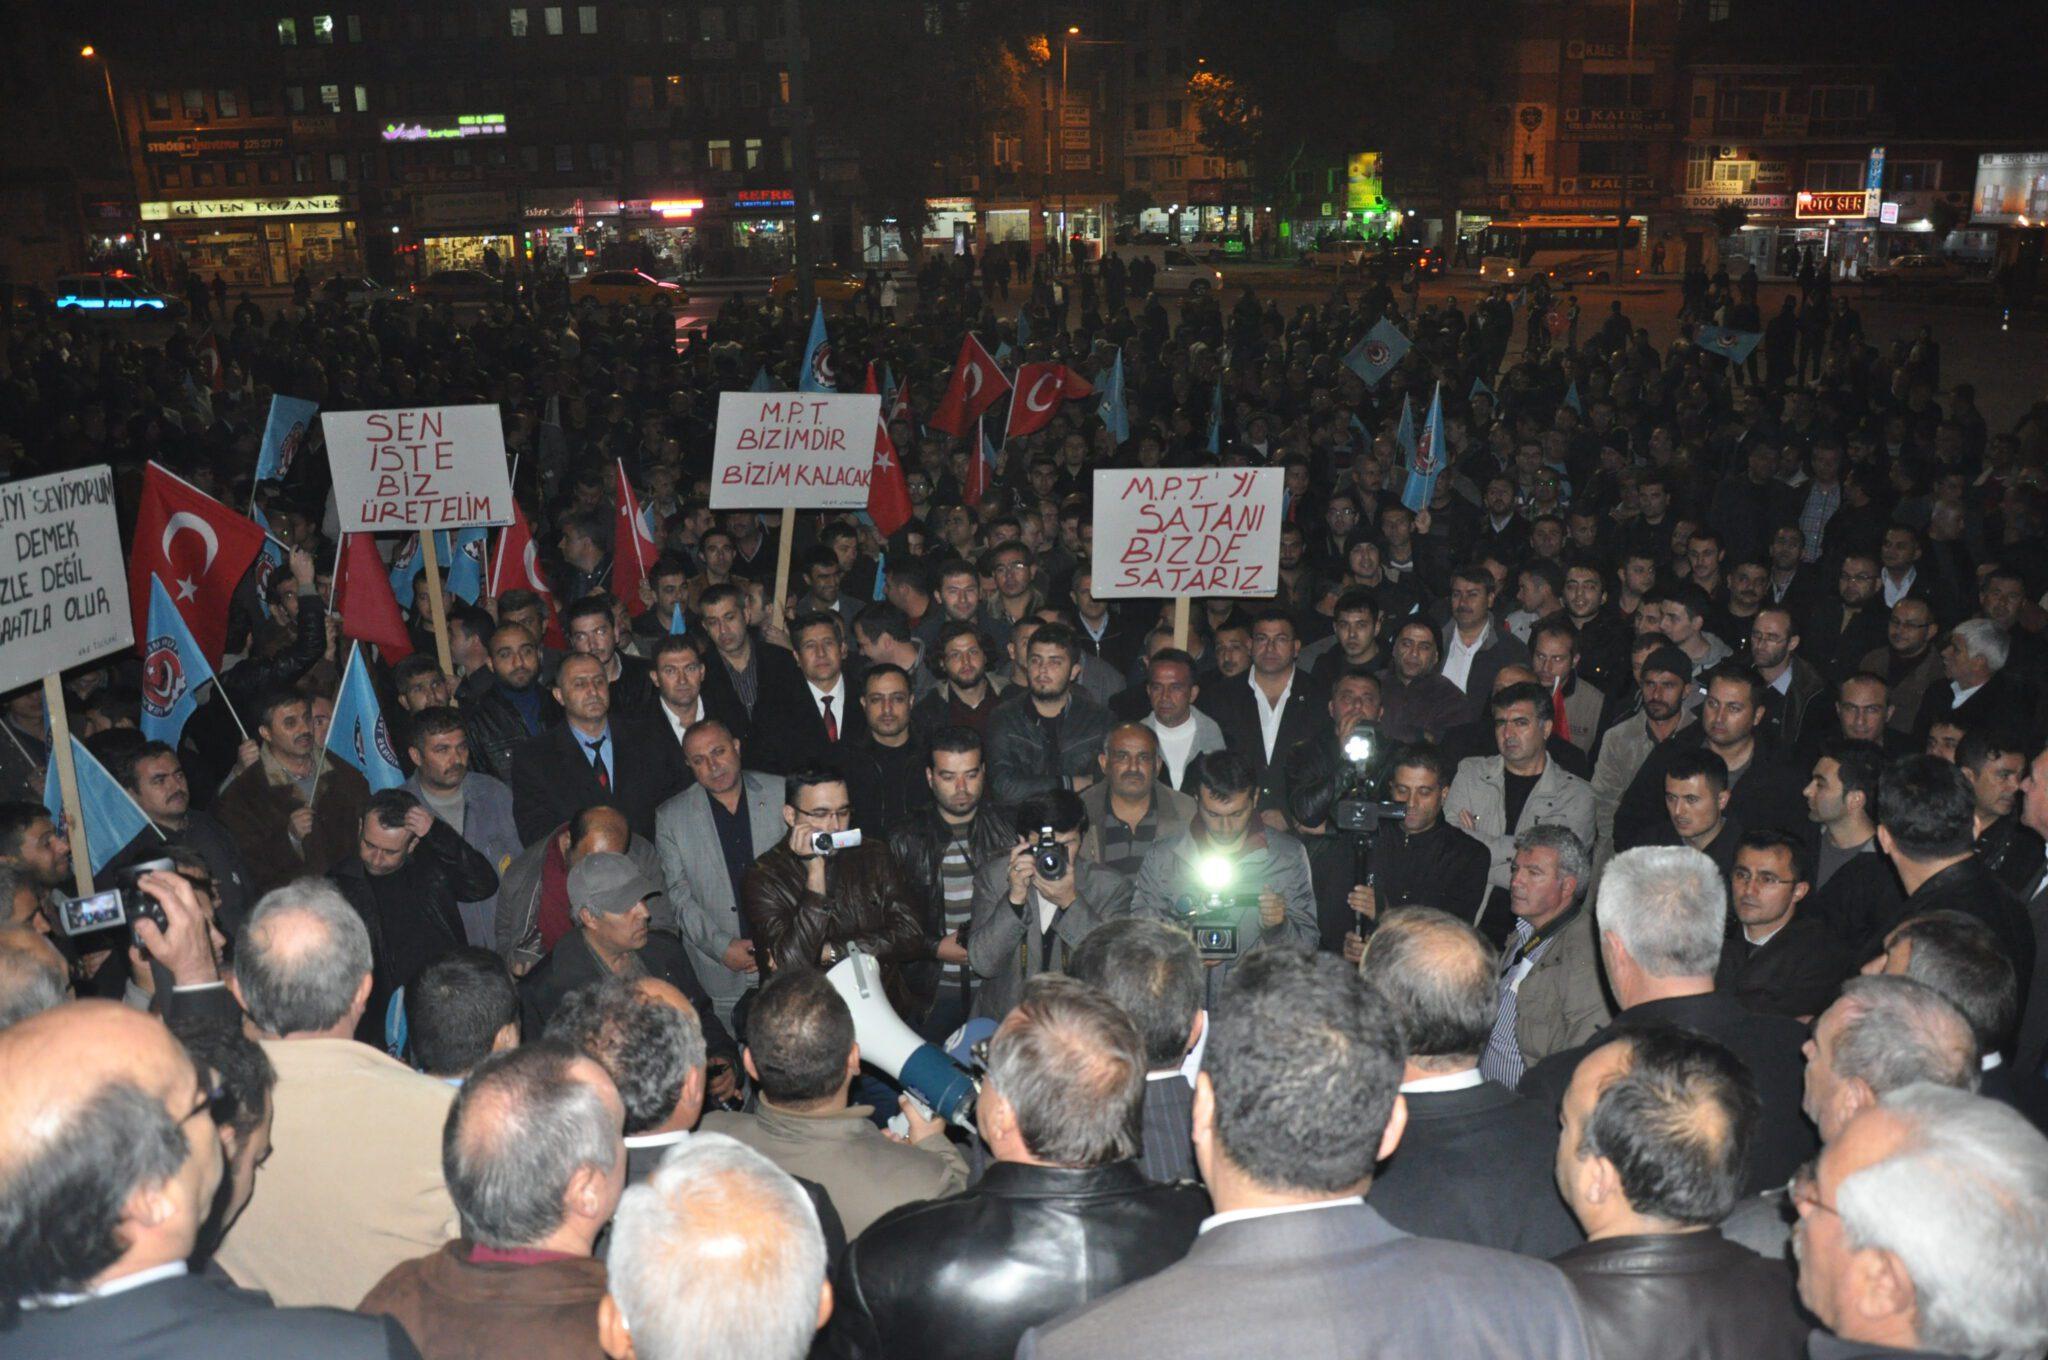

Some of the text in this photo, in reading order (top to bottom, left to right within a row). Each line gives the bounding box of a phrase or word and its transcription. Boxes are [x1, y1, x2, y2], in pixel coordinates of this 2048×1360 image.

[175, 201, 244, 215] GÜVEN
[366, 411, 443, 442] SEN
[736, 426, 846, 451] BİZİMDİR
[376, 471, 439, 497] BİZ
[722, 461, 791, 486] BİZİM
[360, 491, 492, 524] ÜRETELİM
[1137, 502, 1265, 534] SATANI
[15, 520, 80, 562] DEMEK
[41, 553, 92, 593] DEĞİL
[1115, 566, 1263, 592] SATARIZ
[0, 603, 52, 646] AATLA
[65, 586, 111, 622] OLUR
